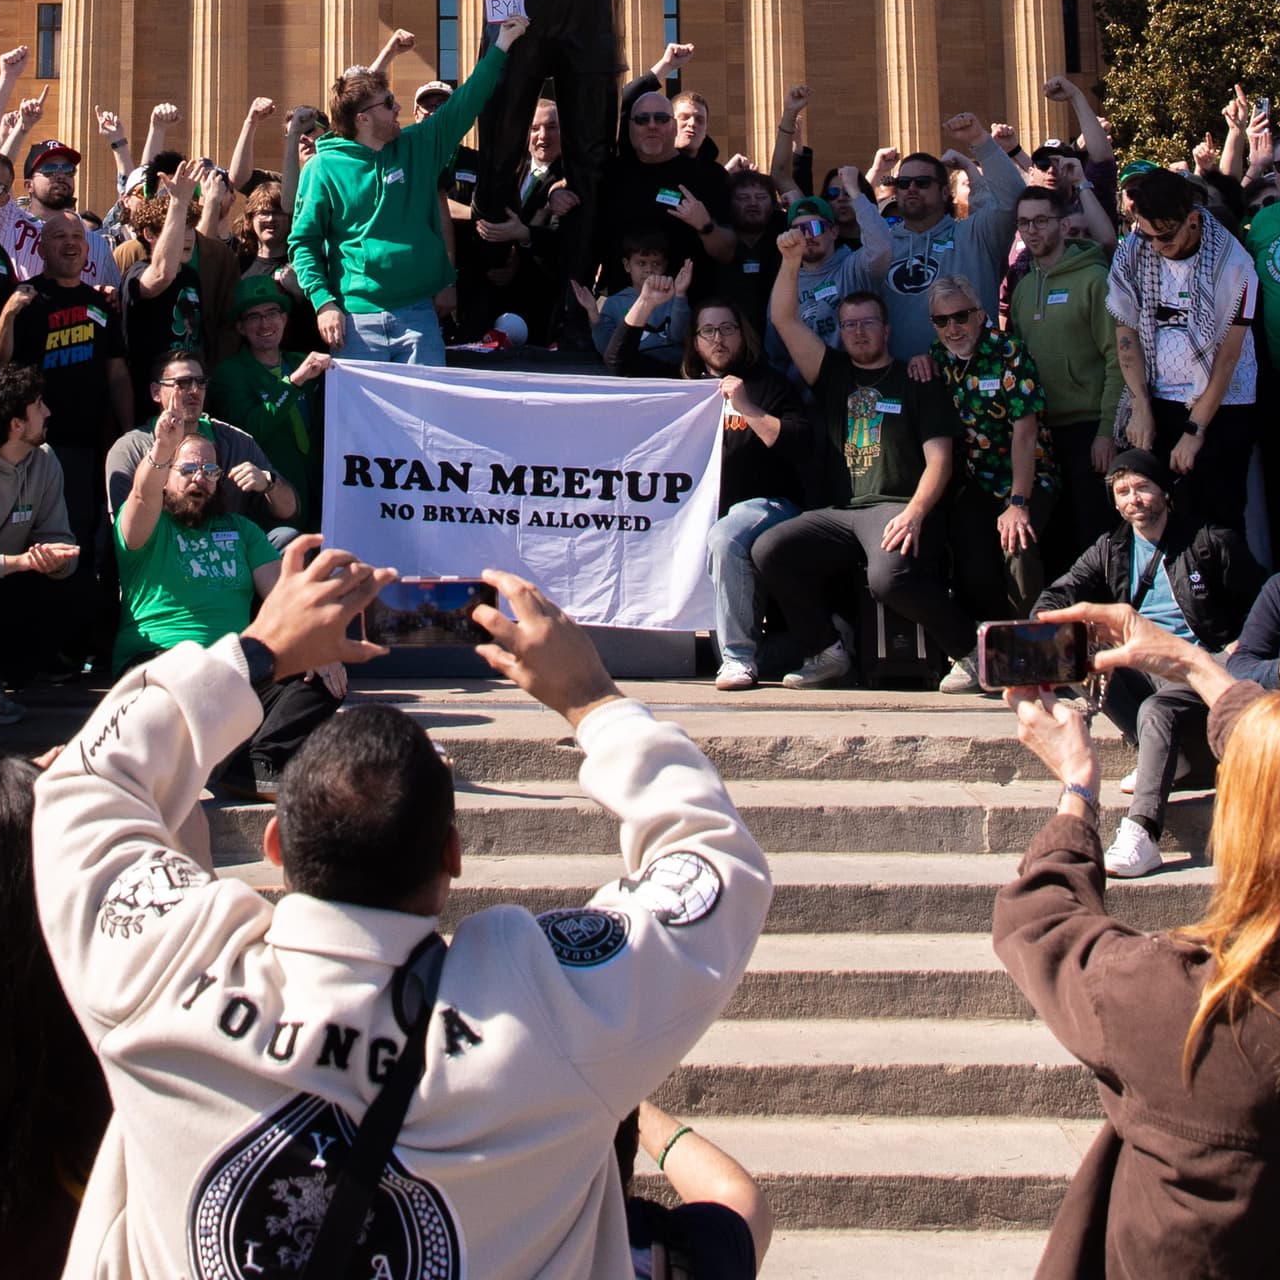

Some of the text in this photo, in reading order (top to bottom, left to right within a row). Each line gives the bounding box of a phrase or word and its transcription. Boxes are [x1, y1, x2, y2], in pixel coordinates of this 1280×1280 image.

[45, 322, 95, 351] RYAN
[42, 343, 94, 369] RYAN
[343, 454, 693, 504] RYAN MEETUP
[380, 503, 652, 532] NO BRYANS ALLOWED
[182, 970, 483, 1086] YOUNGA
[308, 1132, 339, 1168] Y
[242, 1239, 268, 1274] L
[369, 1253, 394, 1280] A
